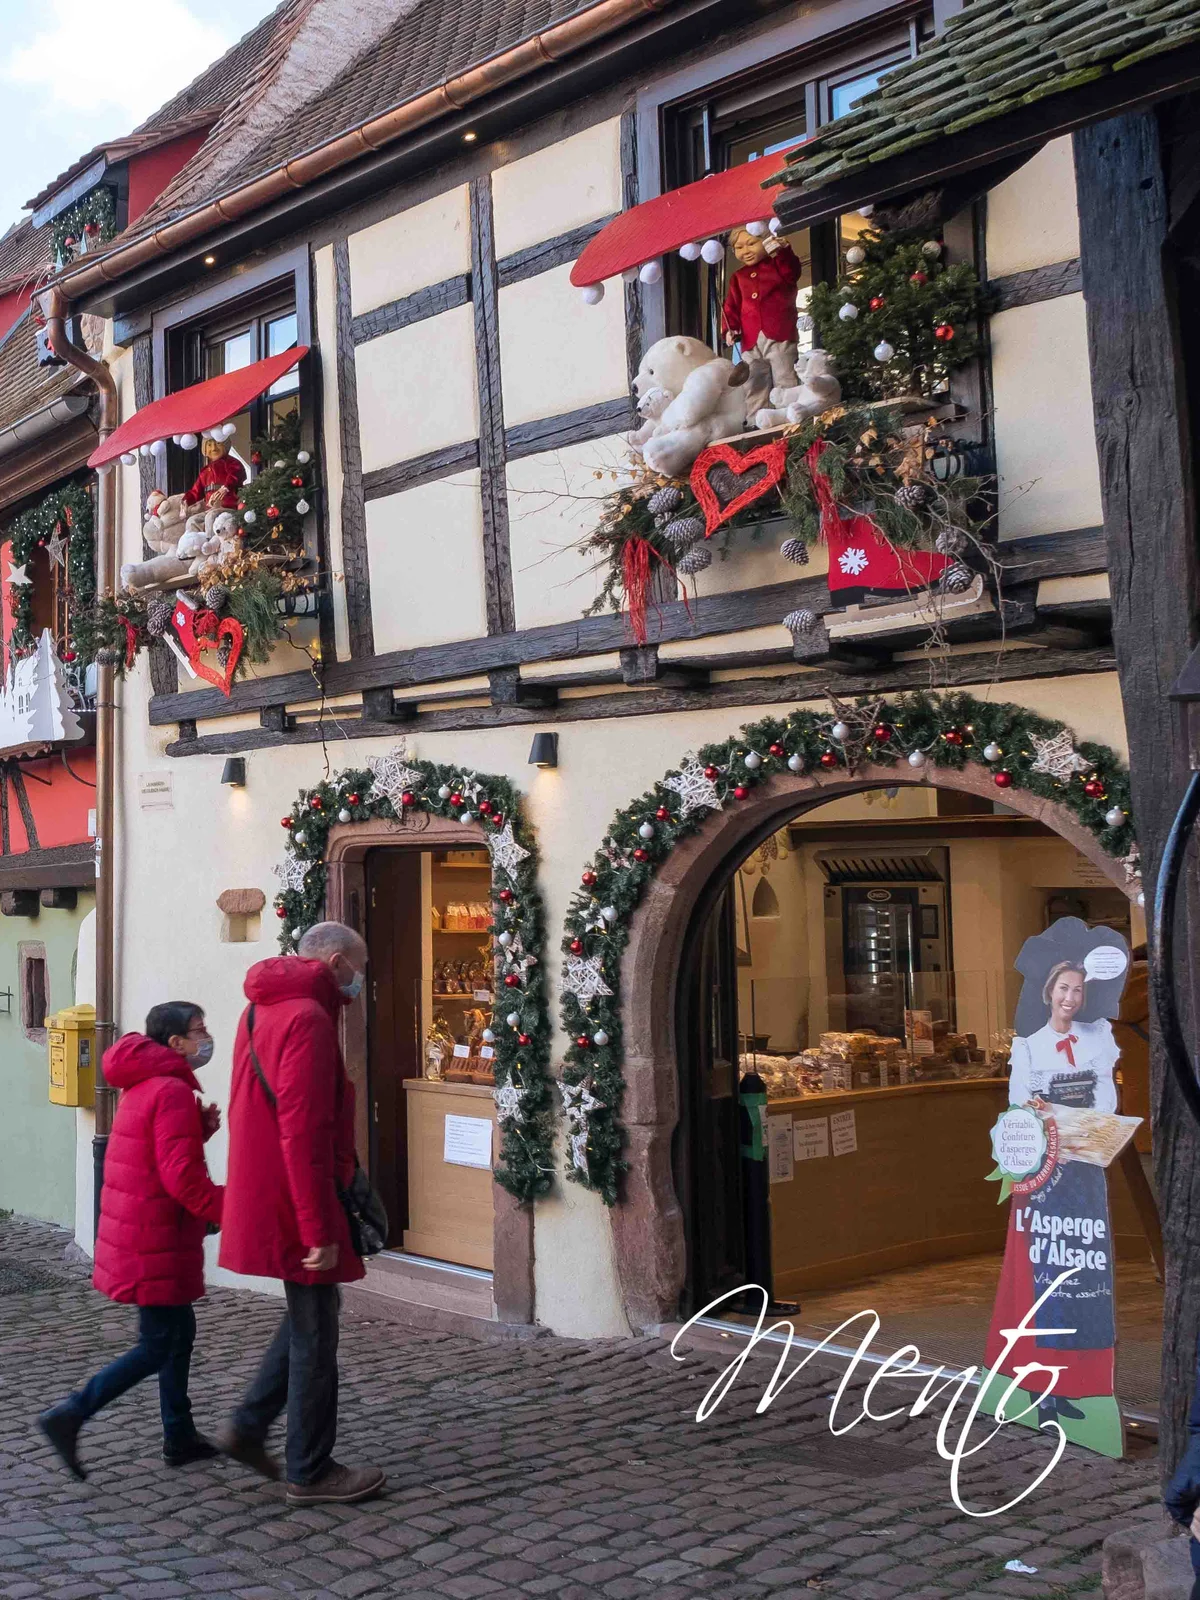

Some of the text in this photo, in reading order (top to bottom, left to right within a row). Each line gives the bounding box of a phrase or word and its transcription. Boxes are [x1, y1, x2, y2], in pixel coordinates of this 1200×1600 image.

[1002, 1118, 1035, 1129] Véritable
[1001, 1131, 1036, 1142] Confiture
[1000, 1143, 1037, 1157] d'asperges
[1035, 1158, 1052, 1184] TERROIR
[1048, 1125, 1058, 1160] ALSACIEN
[1003, 1155, 1033, 1167] d'Alsace
[1015, 1206, 1106, 1244] L'Asperge
[1028, 1237, 1107, 1270] d'Alsace
[1047, 1281, 1112, 1299] otre assiette
